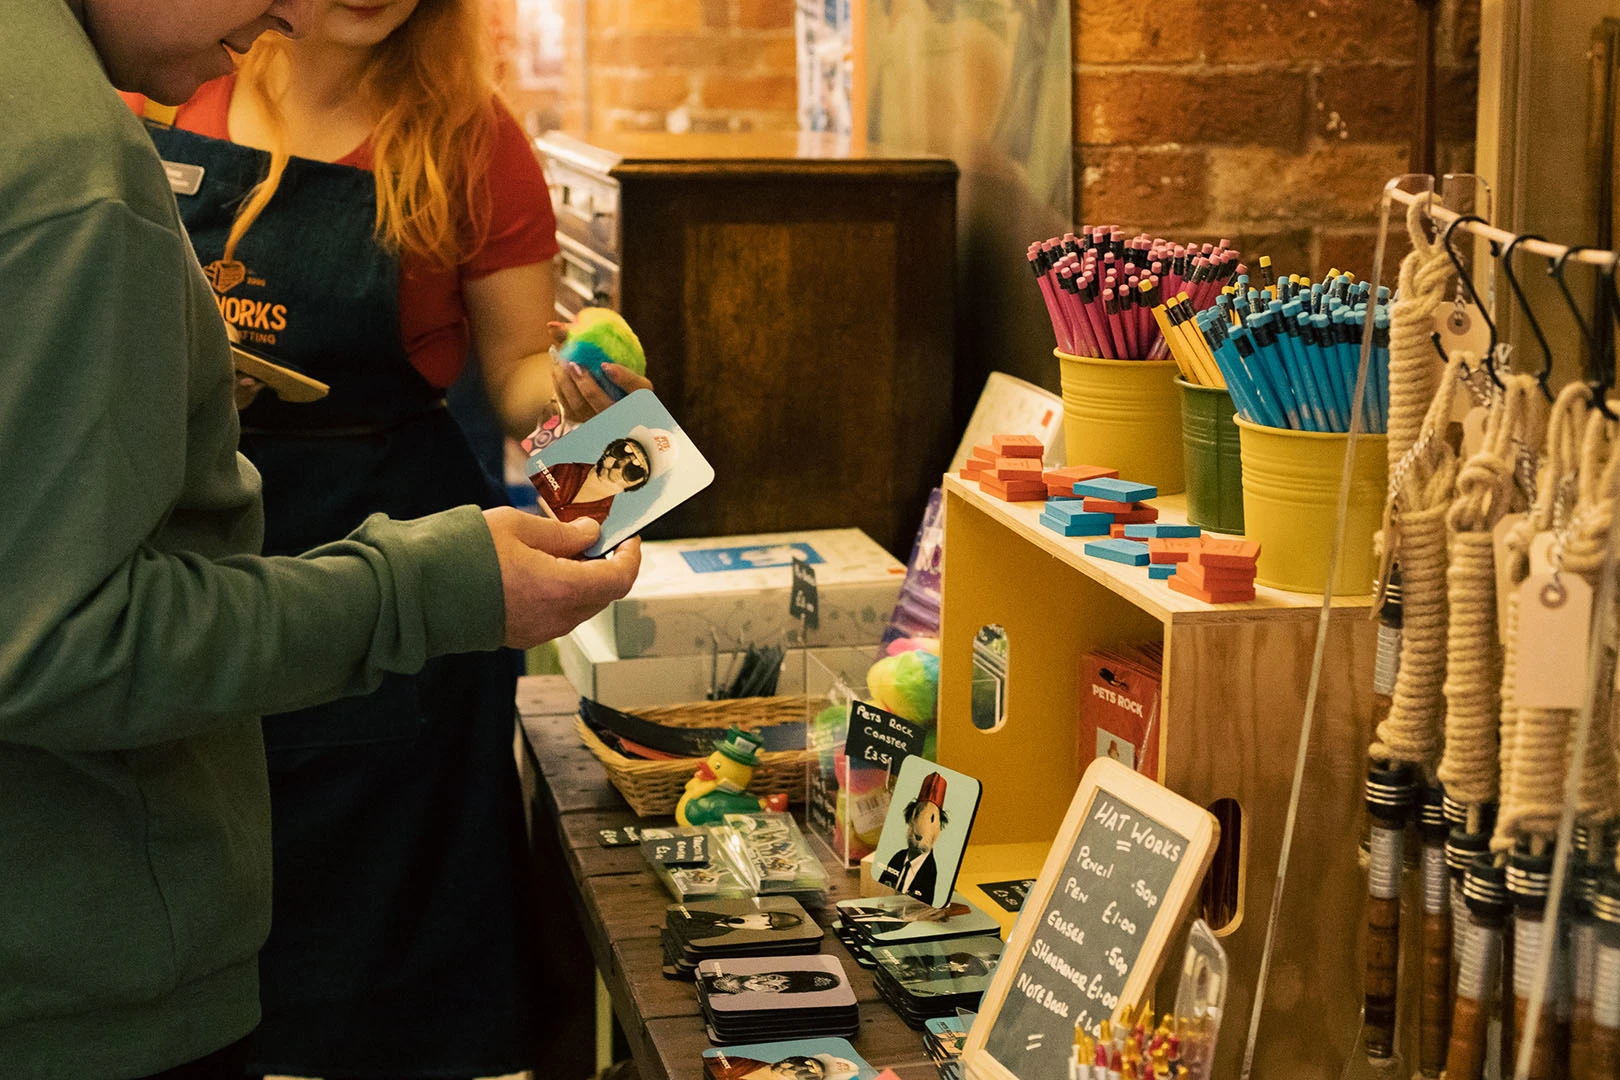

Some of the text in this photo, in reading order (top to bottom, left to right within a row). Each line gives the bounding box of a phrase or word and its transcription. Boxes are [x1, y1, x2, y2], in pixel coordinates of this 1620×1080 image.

[545, 473, 561, 491] ROCK
[1092, 683, 1143, 718] PETS ROCK
[856, 705, 914, 738] PETS ROCK
[864, 726, 907, 752] COASTER
[1094, 801, 1181, 862] HAT WORKS
[1077, 845, 1114, 879] Pencil
[1064, 876, 1089, 904] PEN
[1047, 910, 1085, 945] ERASER
[1031, 939, 1087, 992] SHARPENER
[1074, 1009, 1101, 1039] £1.0
